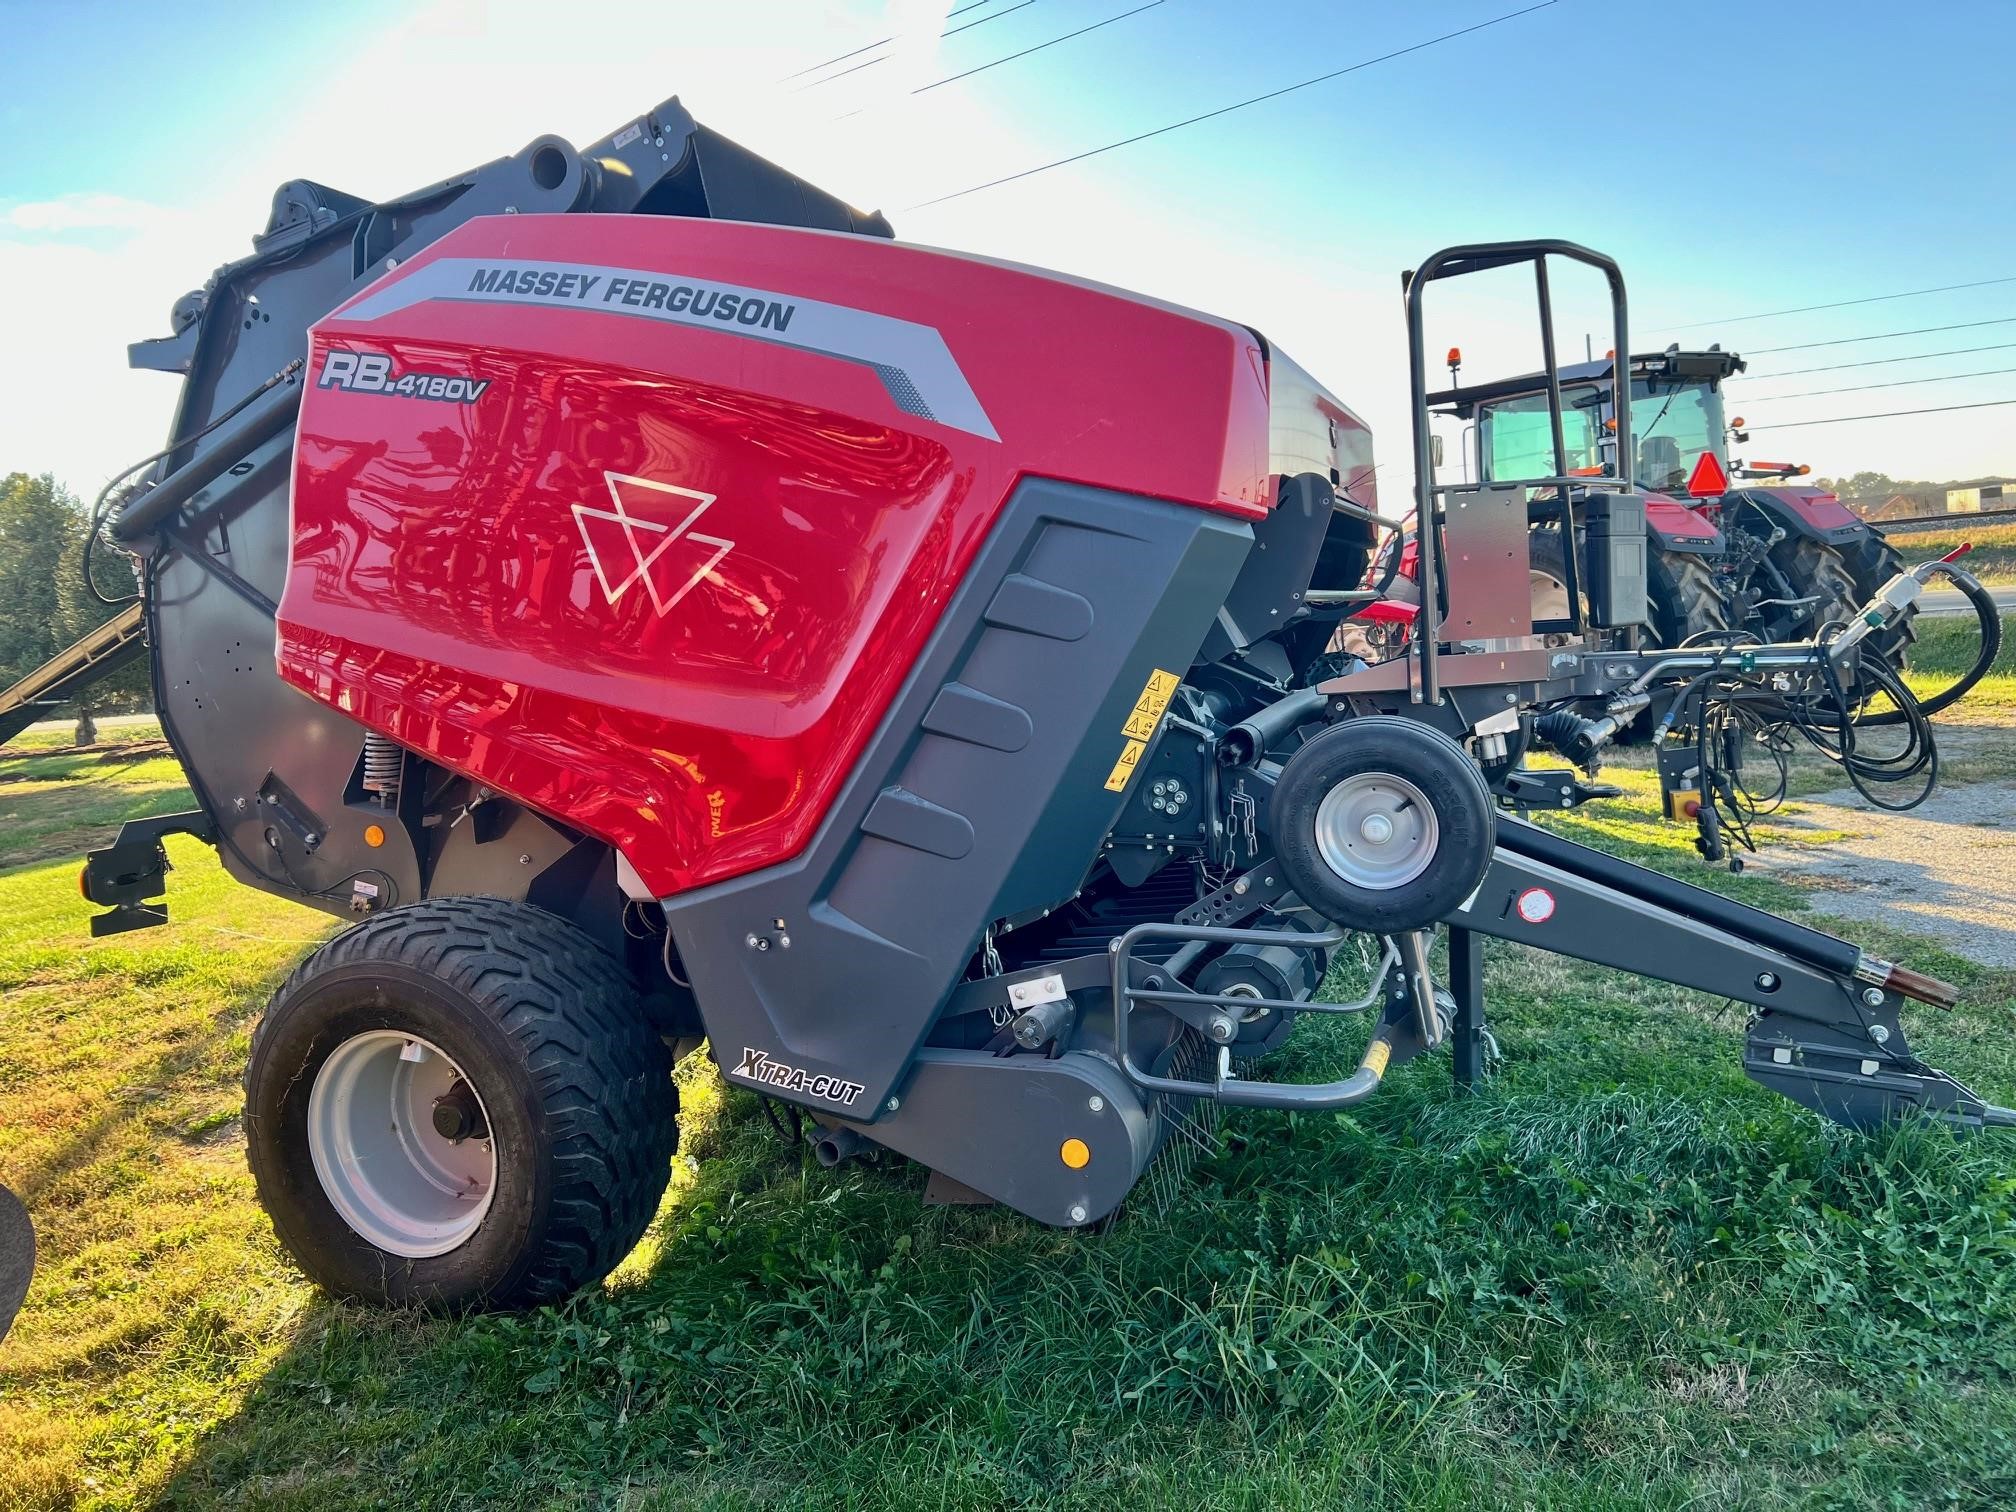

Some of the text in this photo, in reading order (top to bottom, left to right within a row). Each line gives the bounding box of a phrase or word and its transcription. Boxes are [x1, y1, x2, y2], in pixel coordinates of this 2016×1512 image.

[468, 269, 795, 332] MASSEY FERGUSON
[731, 1047, 865, 1105] XTRA-CUT
